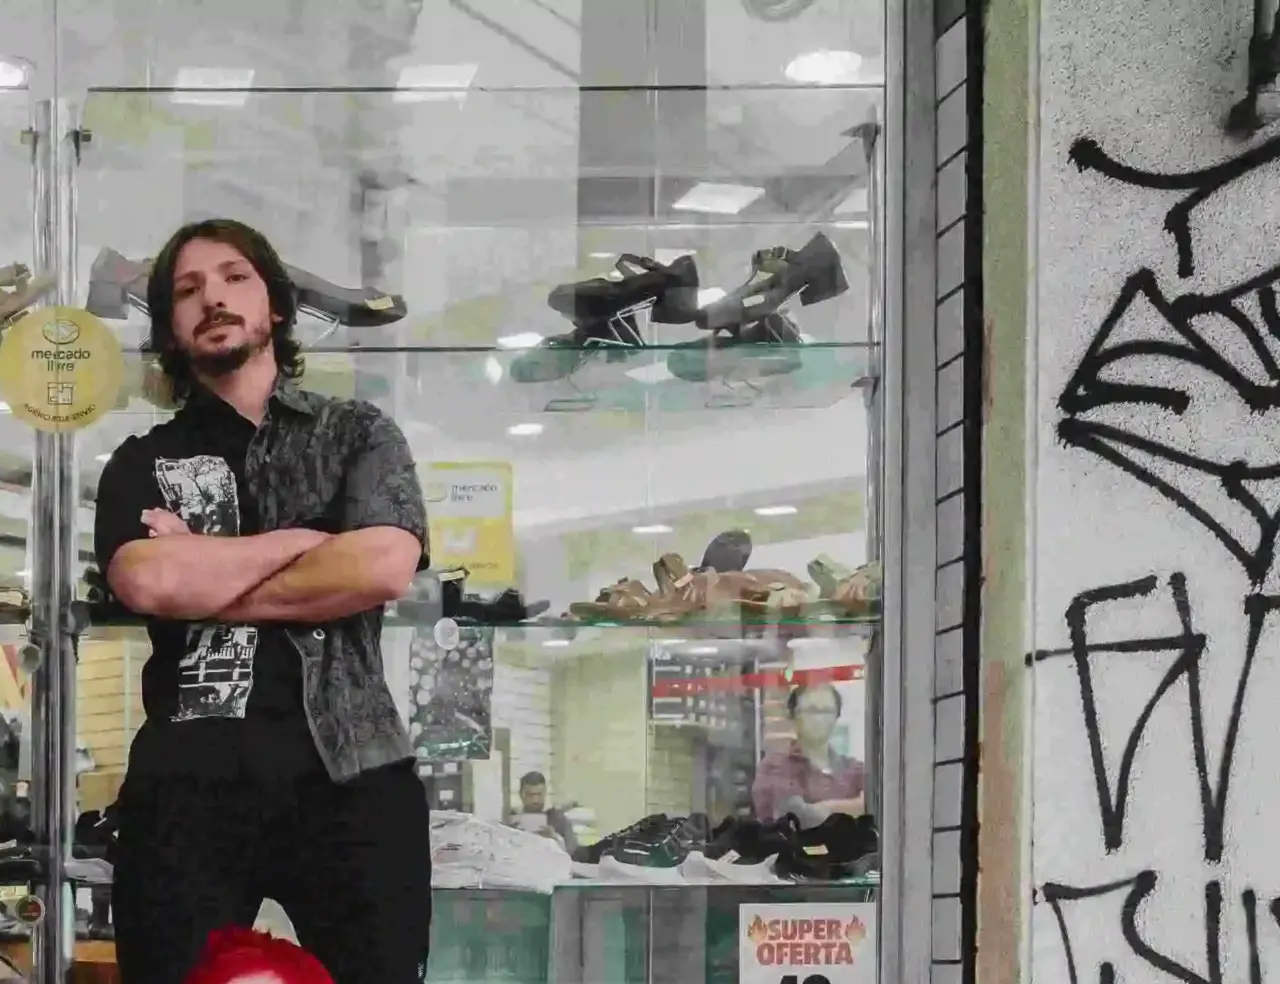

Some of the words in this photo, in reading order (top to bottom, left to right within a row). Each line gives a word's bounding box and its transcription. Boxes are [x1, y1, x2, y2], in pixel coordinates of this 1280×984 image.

[31, 347, 91, 360] mercado
[767, 918, 842, 941] SUPER
[756, 942, 854, 966] OFERTA
